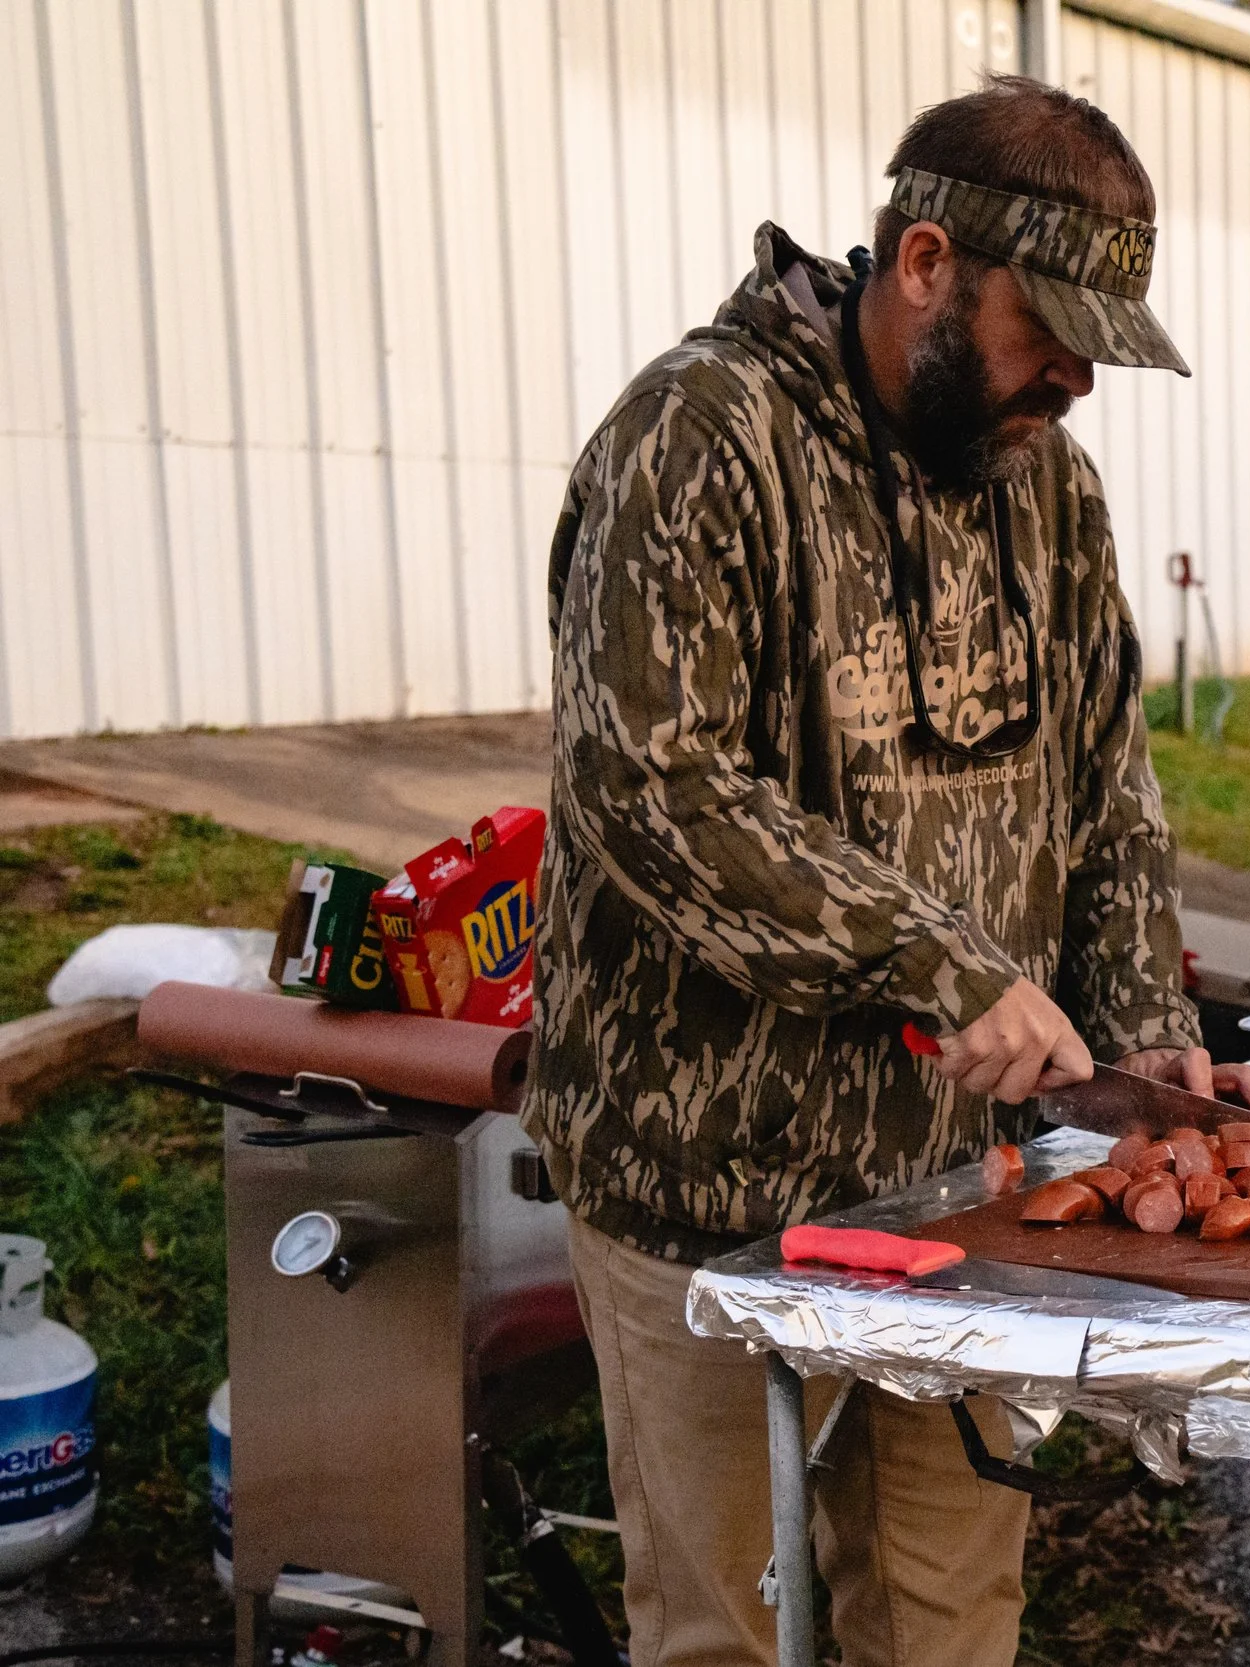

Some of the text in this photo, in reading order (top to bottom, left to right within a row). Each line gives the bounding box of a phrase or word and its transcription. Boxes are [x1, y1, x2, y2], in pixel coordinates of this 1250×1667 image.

[864, 621, 906, 668] Th
[476, 828, 493, 853] RITZ
[380, 912, 417, 939] RITZ
[460, 877, 535, 981] RITZ
